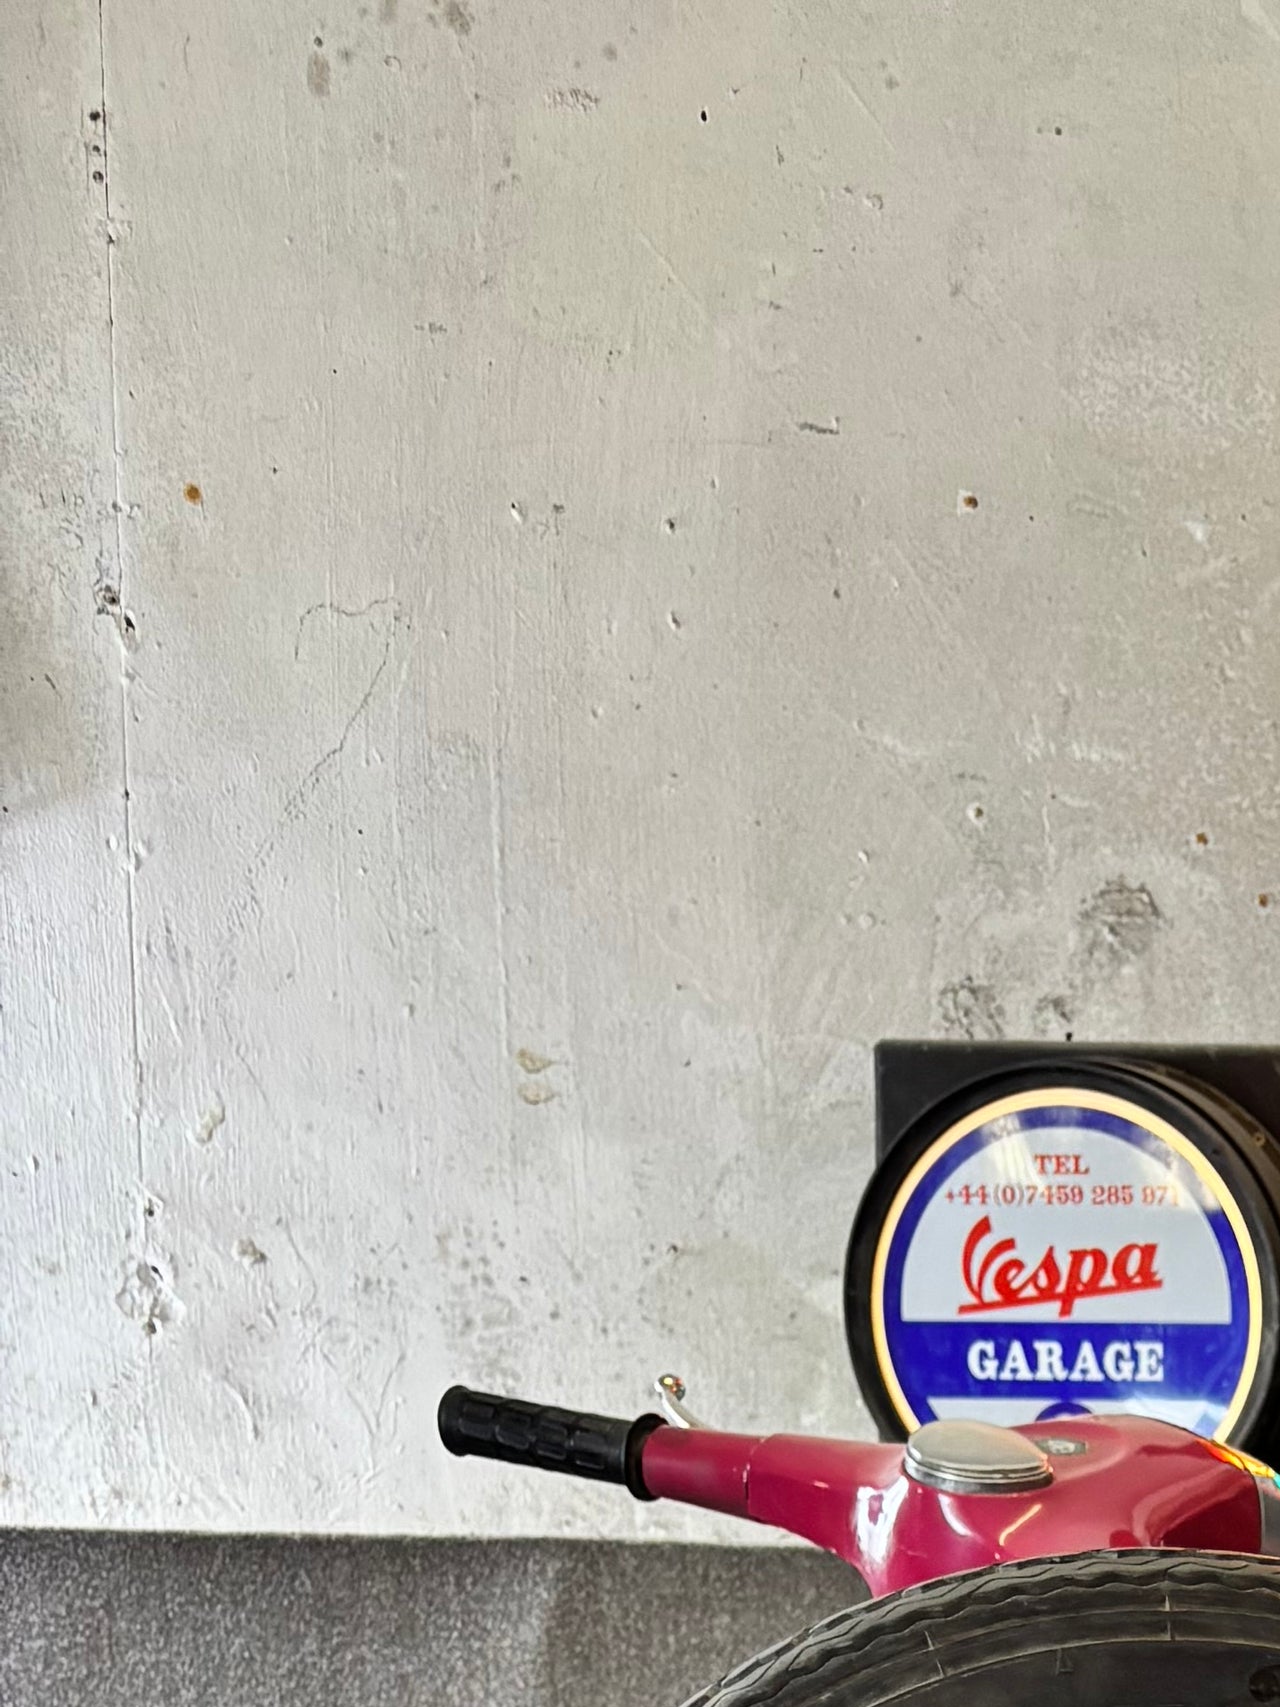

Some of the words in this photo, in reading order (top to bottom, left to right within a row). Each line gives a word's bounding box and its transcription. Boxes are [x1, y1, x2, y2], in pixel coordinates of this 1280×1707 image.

[1034, 1154, 1090, 1176] TEL
[1092, 1186, 1134, 1206] 285
[957, 1215, 1163, 1318] Vespa
[966, 1340, 1164, 1383] GARAGE
